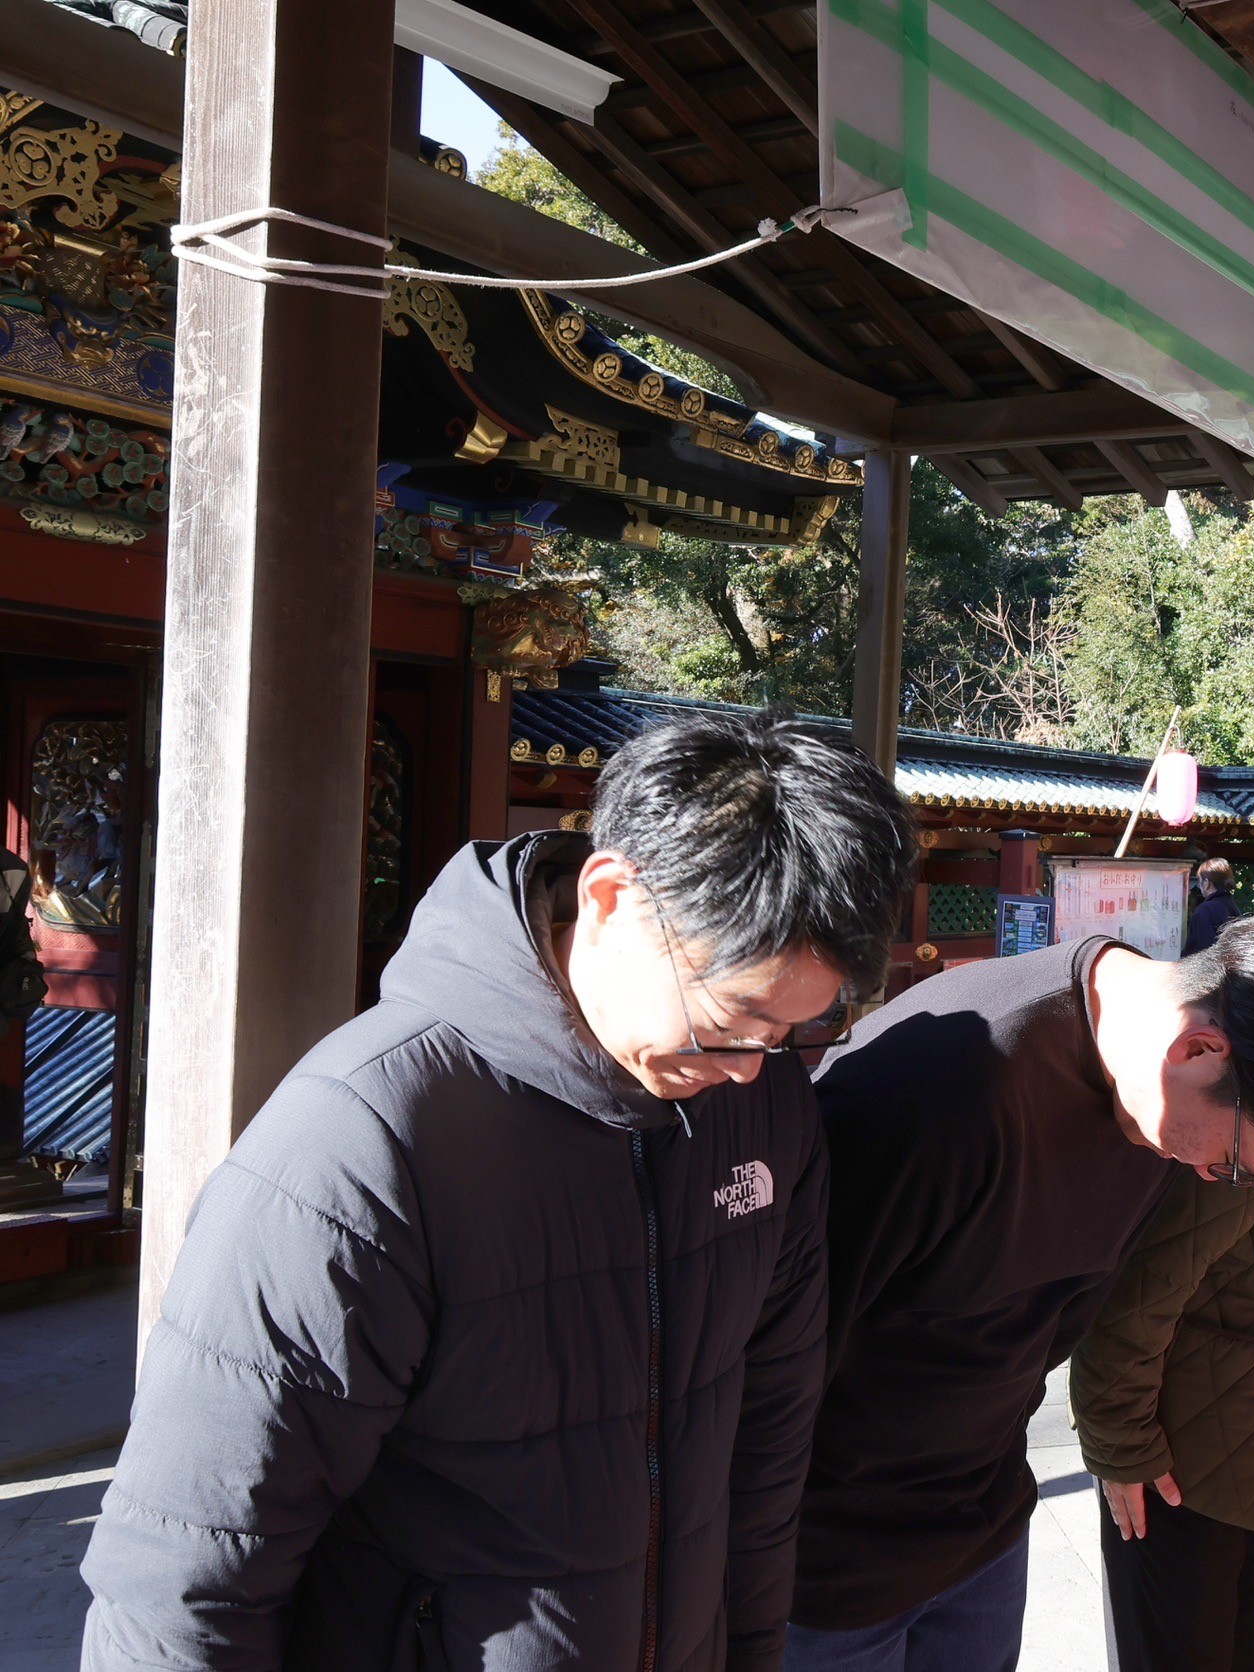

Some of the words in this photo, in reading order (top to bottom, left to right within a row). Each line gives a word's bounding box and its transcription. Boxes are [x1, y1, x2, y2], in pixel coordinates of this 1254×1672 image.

[731, 1162, 756, 1183] THE
[713, 1178, 756, 1208] NORTH
[728, 1194, 756, 1220] FACE
